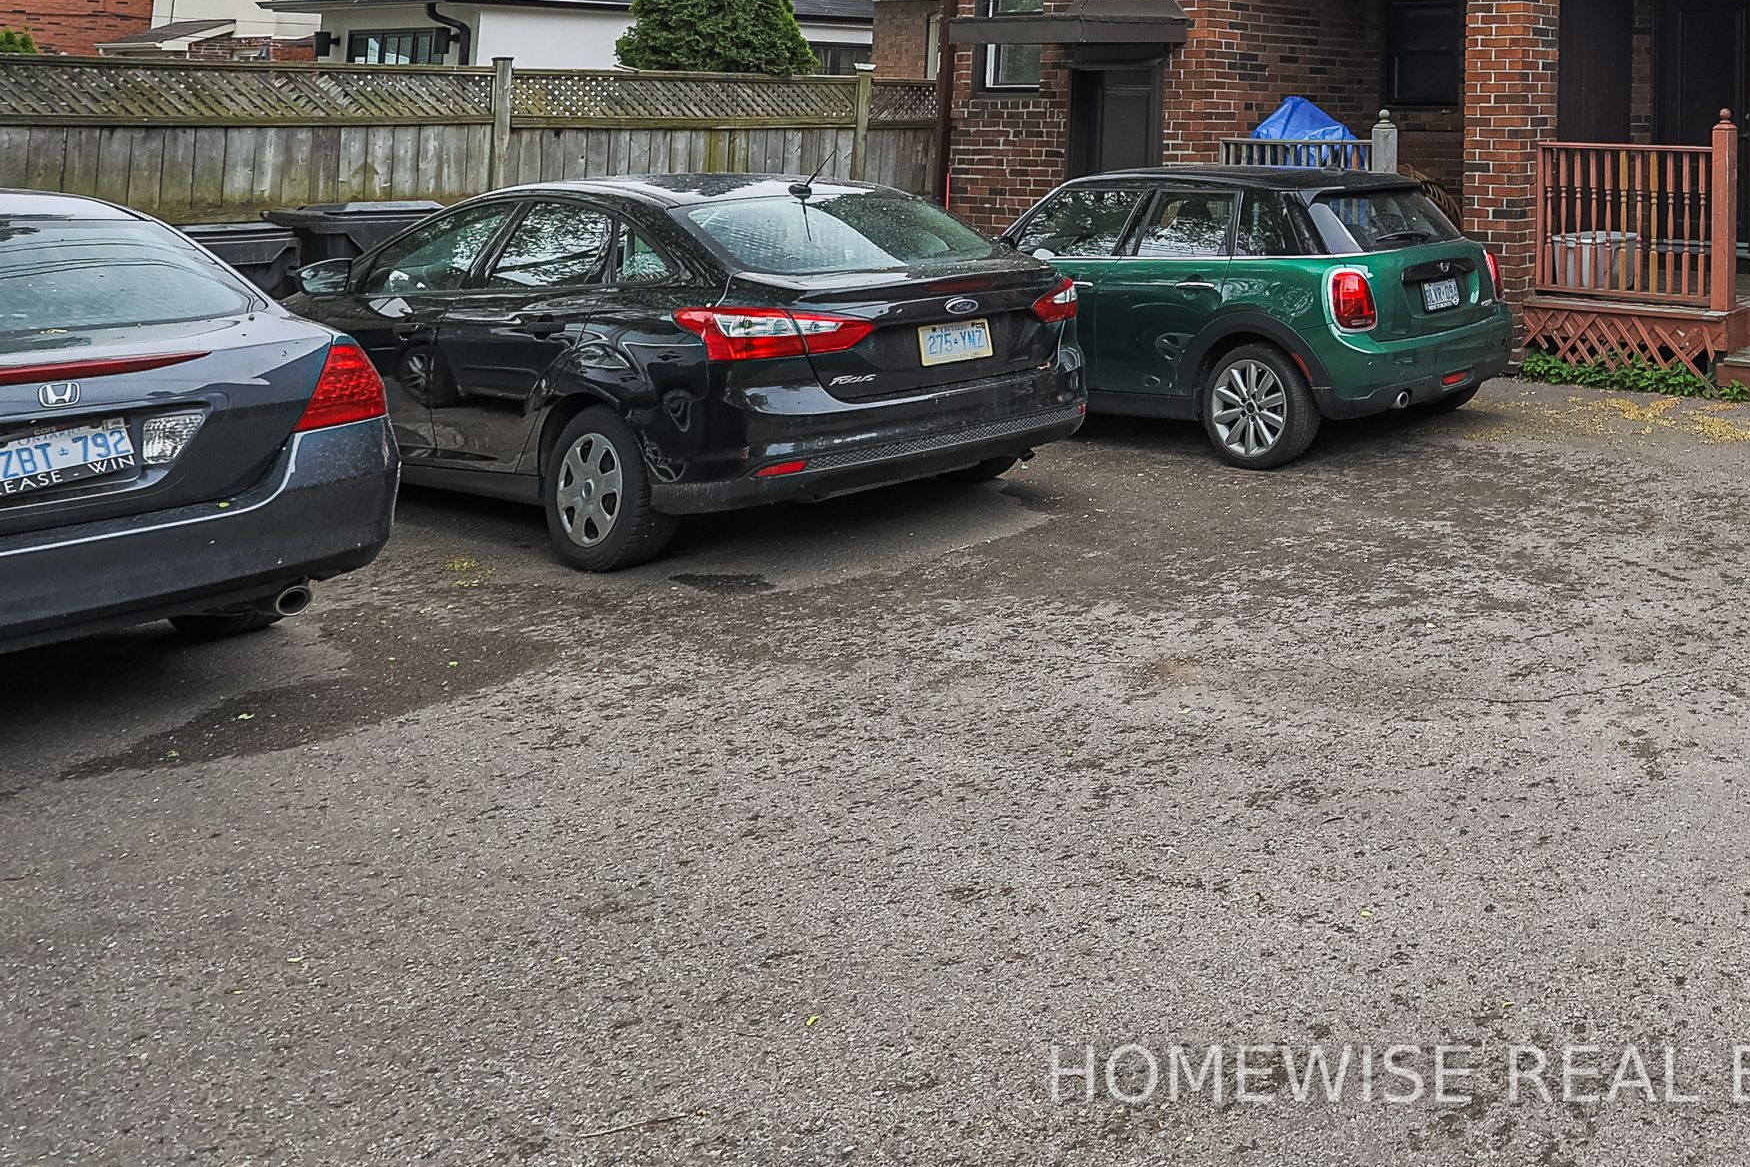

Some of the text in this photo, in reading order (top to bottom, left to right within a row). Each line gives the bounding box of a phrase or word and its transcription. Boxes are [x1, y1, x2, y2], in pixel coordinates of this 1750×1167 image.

[927, 333, 953, 355] 275
[72, 430, 131, 463] 792
[0, 470, 64, 495] EASE
[87, 454, 136, 474] WIN
